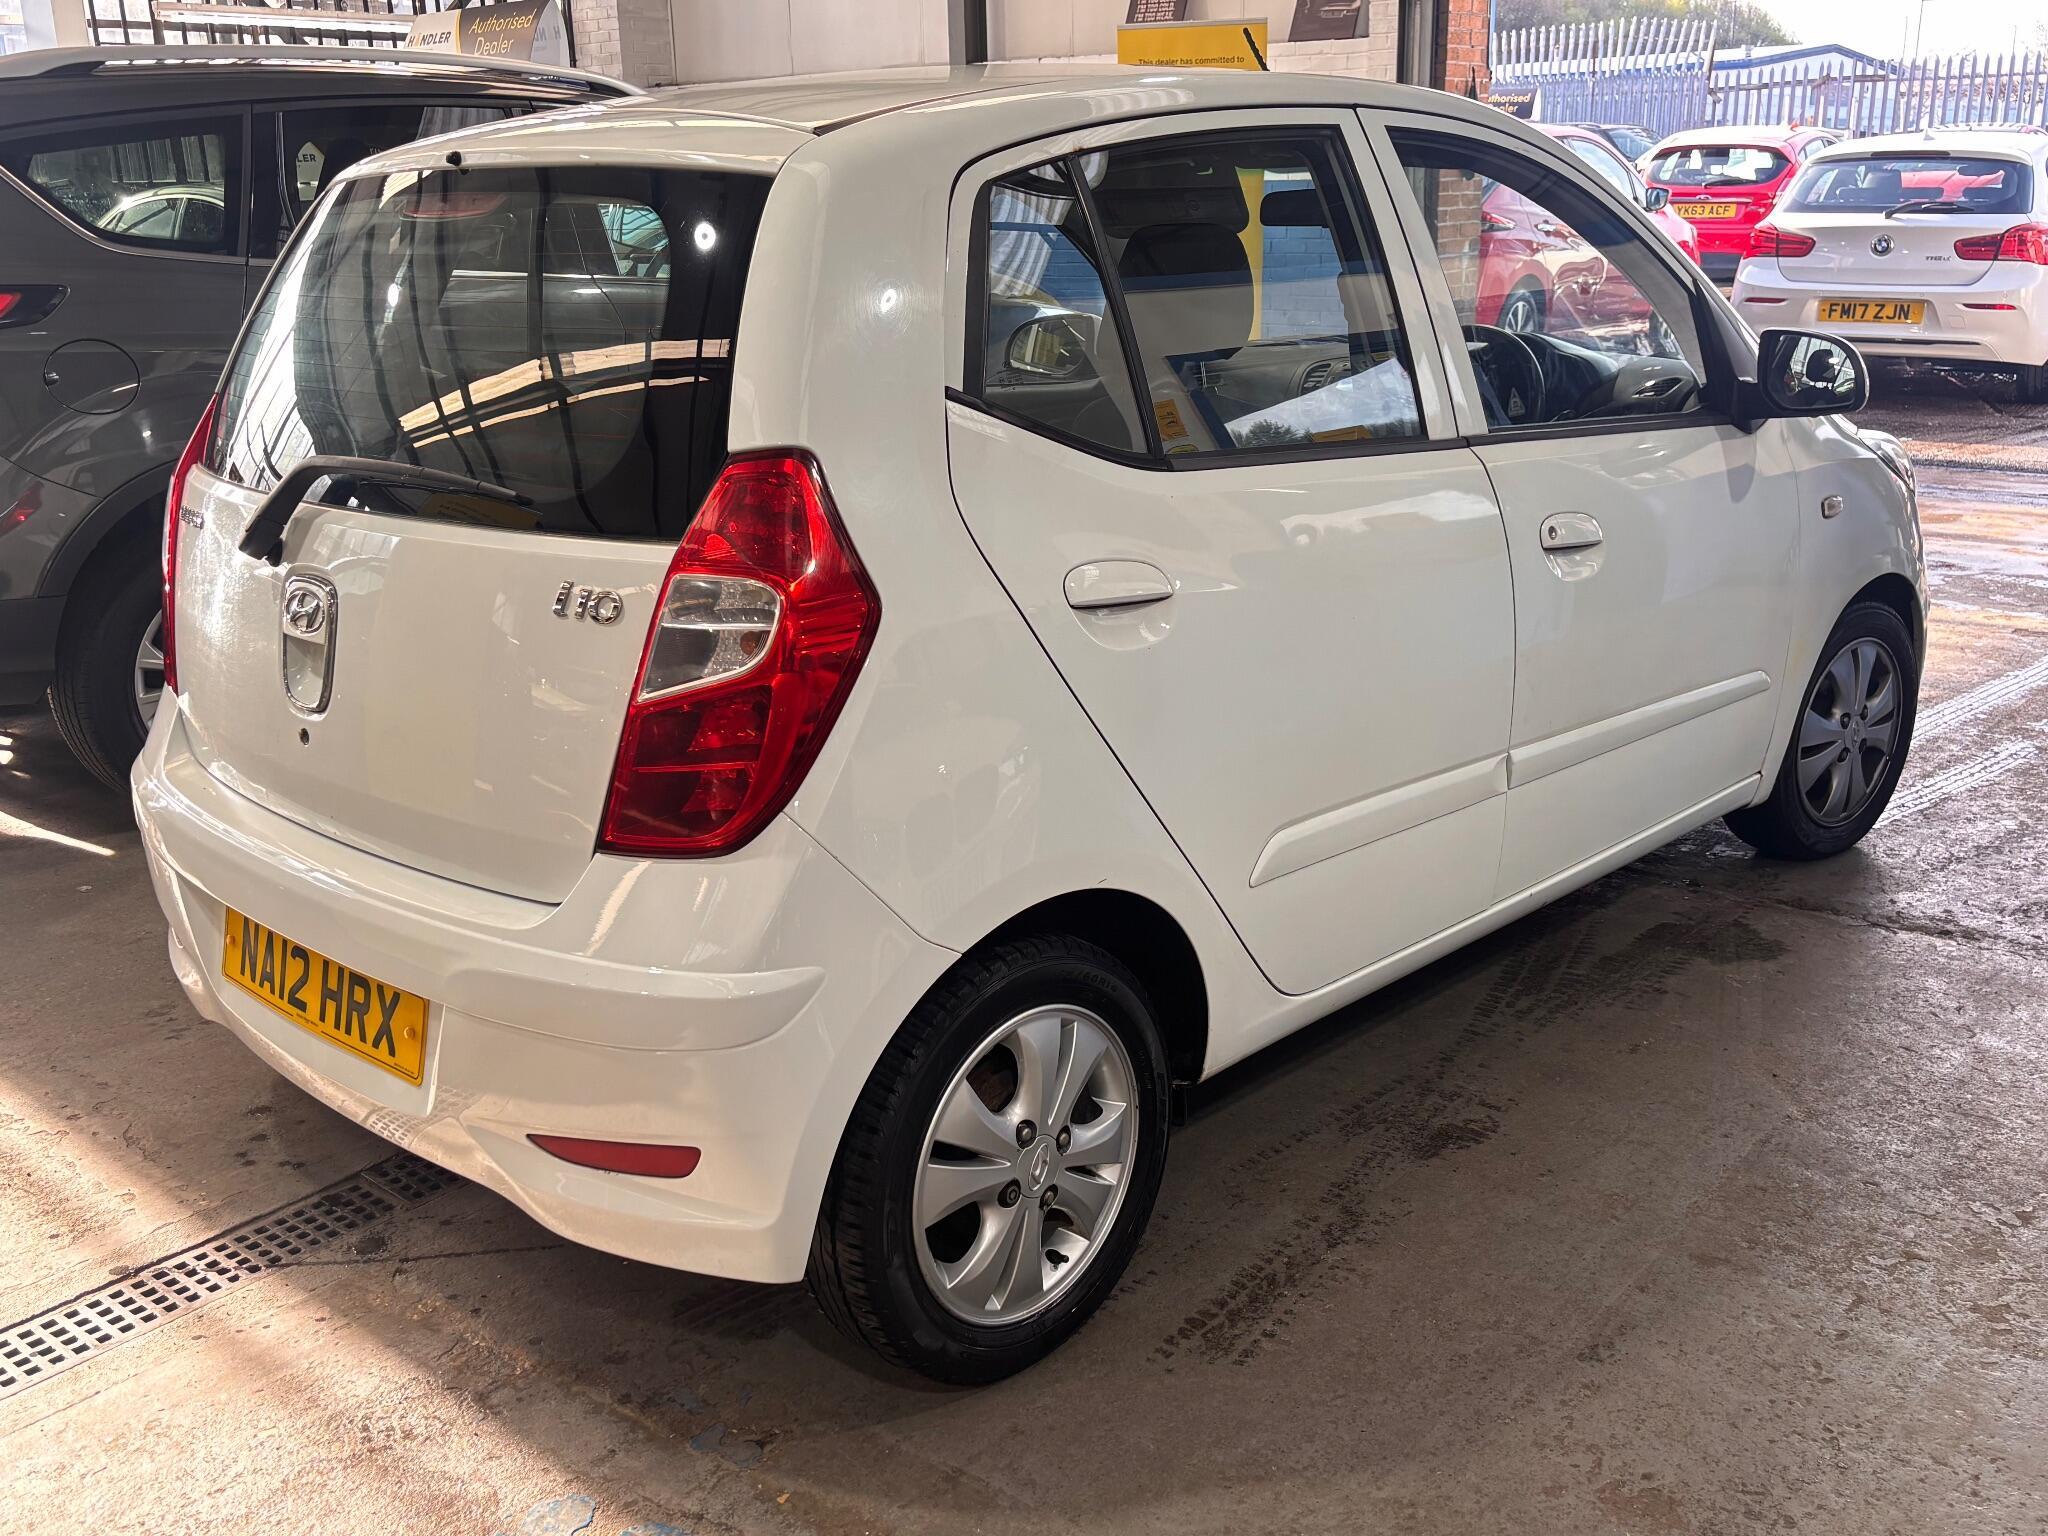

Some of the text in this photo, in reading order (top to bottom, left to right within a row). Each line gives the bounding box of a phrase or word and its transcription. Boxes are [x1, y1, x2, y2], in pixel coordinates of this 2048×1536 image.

[468, 8, 537, 35] Authorised
[474, 33, 514, 56] Dealer
[1155, 57, 1179, 65] dealer
[1180, 57, 1193, 65] has
[1194, 56, 1236, 65] committed
[1237, 56, 1245, 64] to
[1677, 205, 1731, 216] YK63 ACF
[1828, 303, 1910, 321] FM17 ZJN
[240, 916, 401, 1058] NA12 HRX
